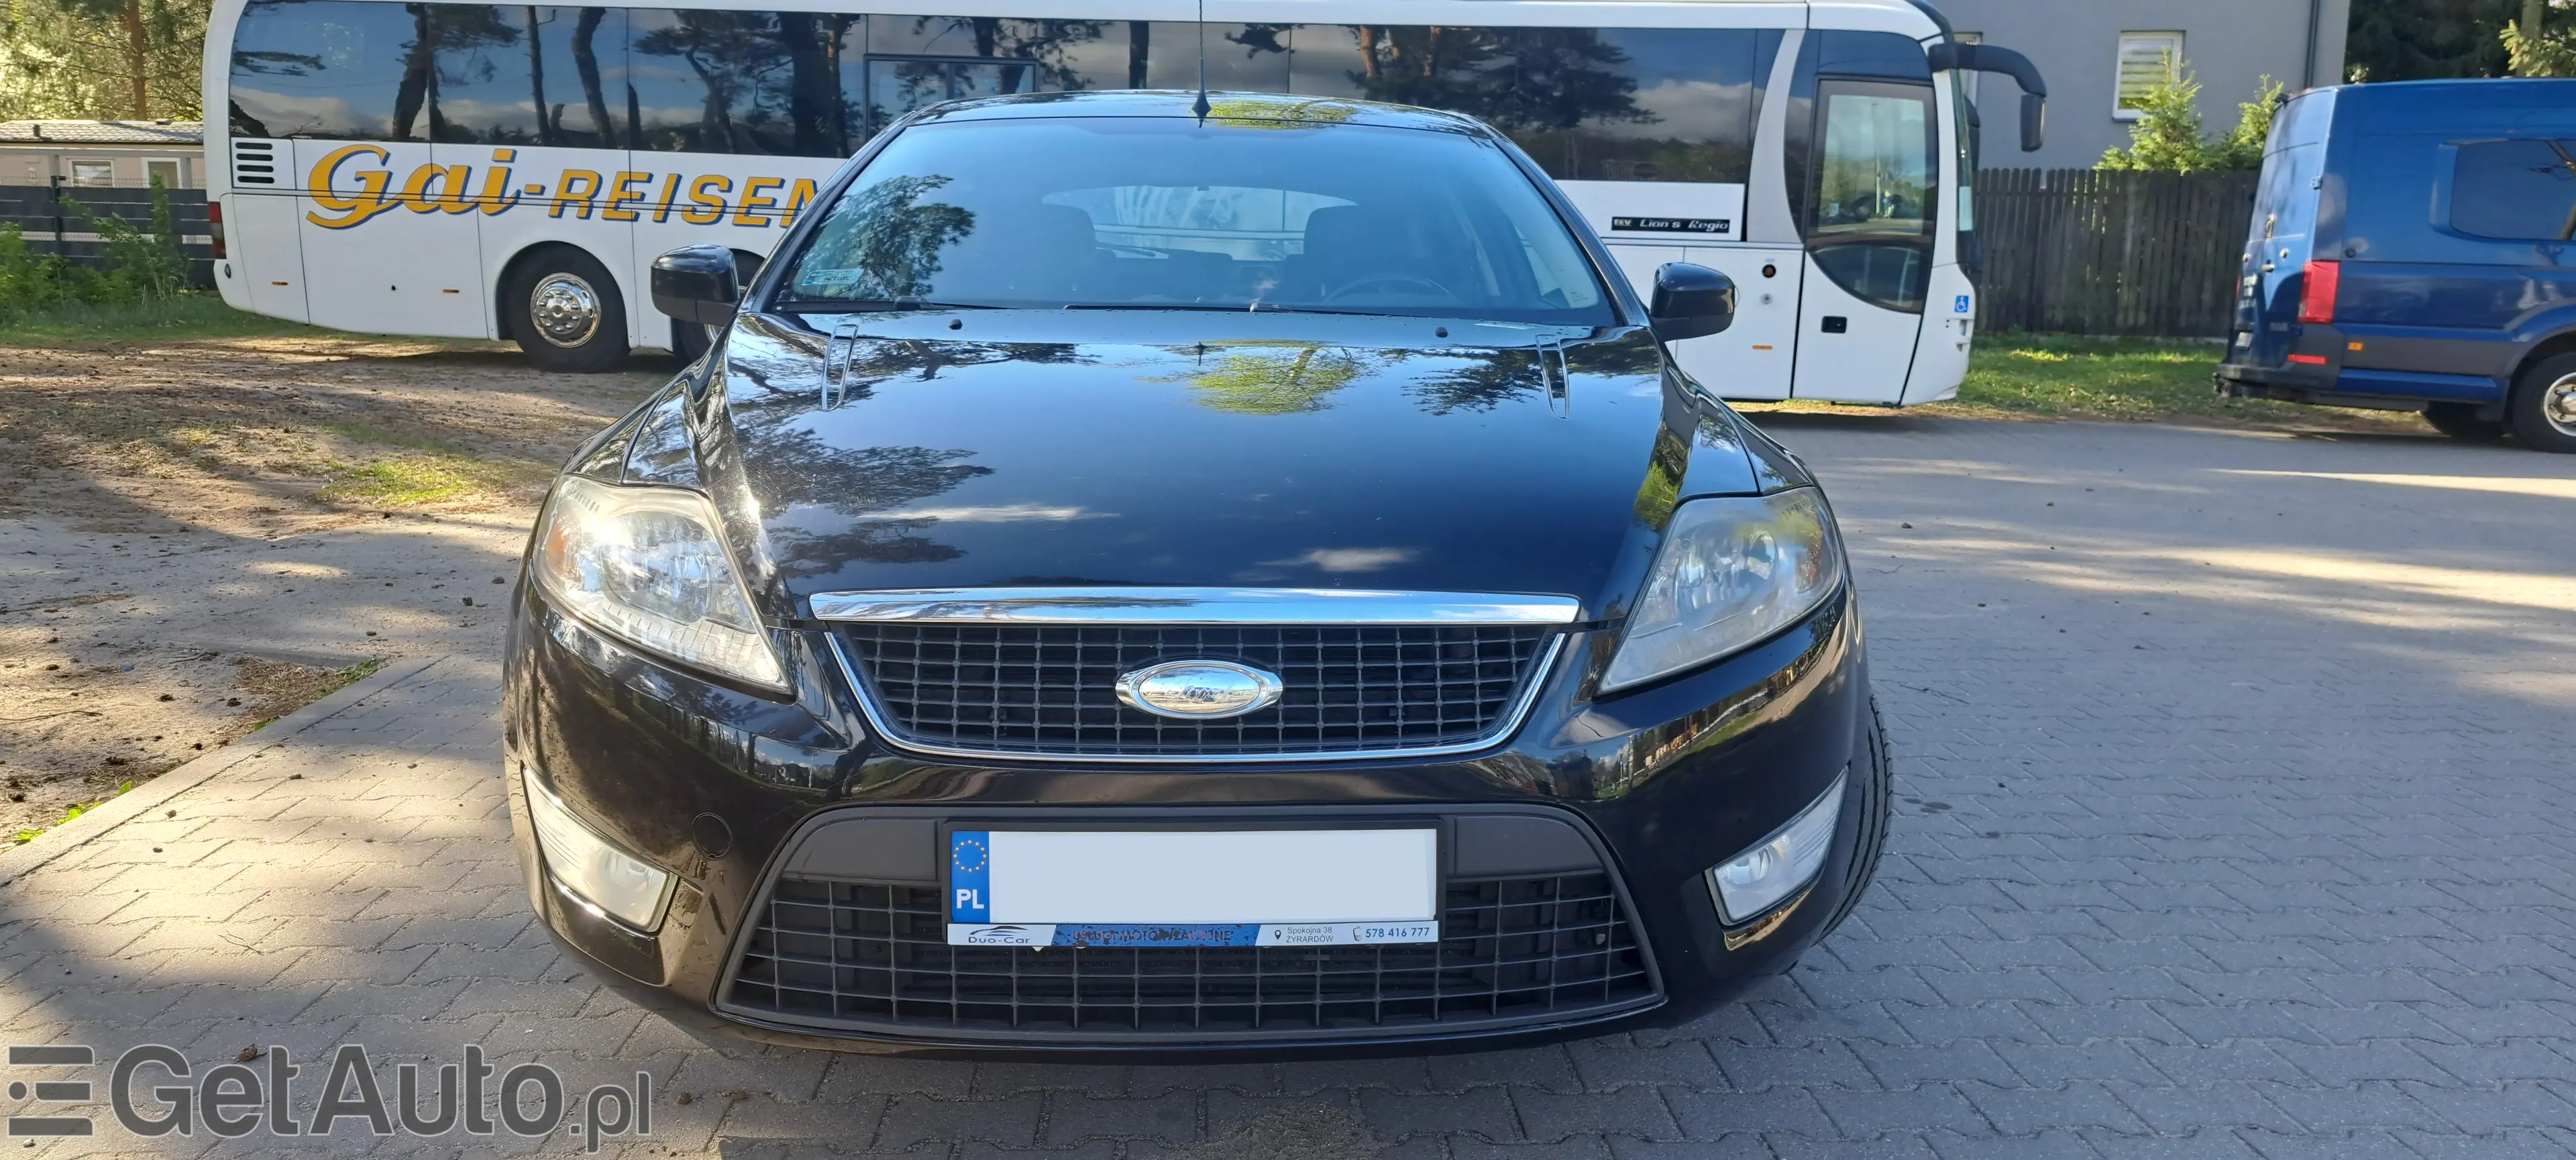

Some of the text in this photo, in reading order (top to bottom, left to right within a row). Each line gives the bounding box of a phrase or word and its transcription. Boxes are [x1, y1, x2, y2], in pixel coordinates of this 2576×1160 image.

[1613, 219, 1632, 227] EEV
[1687, 220, 1729, 231] Regio
[957, 889, 984, 908] PL
[1287, 927, 1321, 935] Spokojna
[1365, 927, 1430, 938] 578 416 777
[1286, 935, 1334, 943] ŻYRARDÓW
